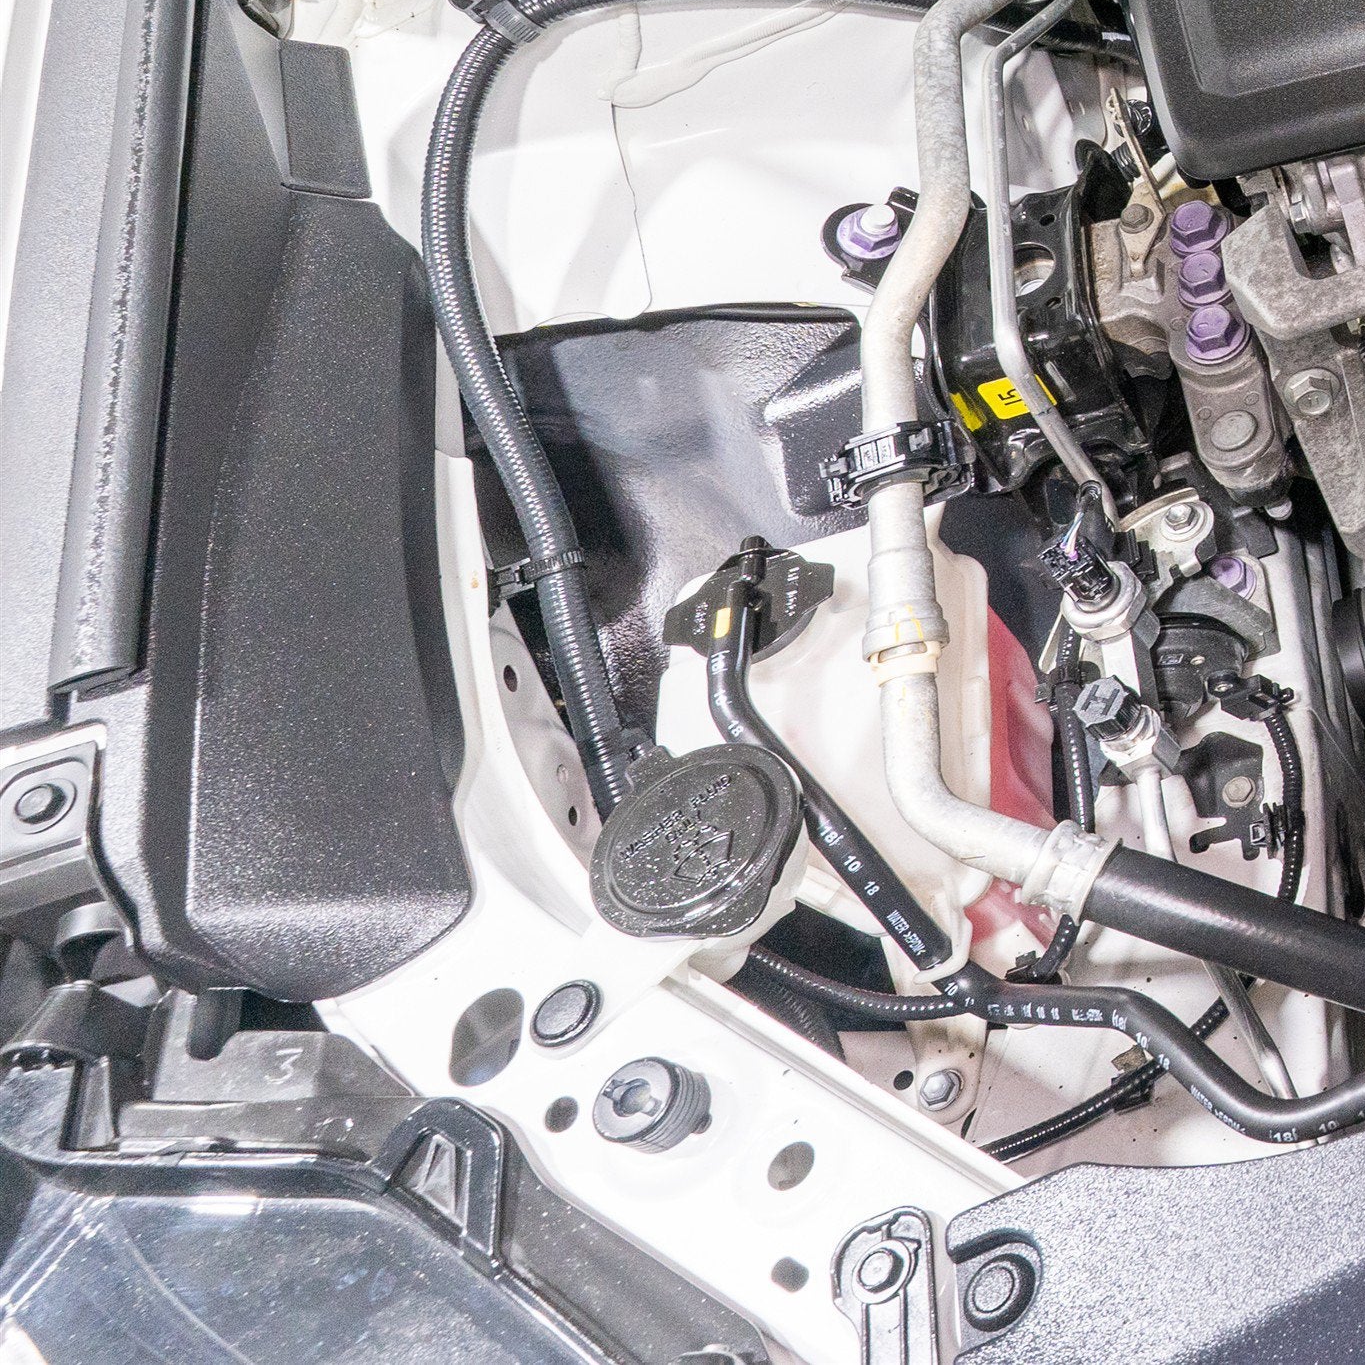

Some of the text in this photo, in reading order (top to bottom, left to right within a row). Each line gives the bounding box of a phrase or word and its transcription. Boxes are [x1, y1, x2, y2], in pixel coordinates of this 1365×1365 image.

[1081, 684, 1121, 716] H
[728, 719, 744, 737] 18
[619, 773, 732, 862] WASHER FLUID
[663, 809, 705, 845] ONLY
[864, 880, 880, 897] 18
[886, 909, 910, 934] WATER
[1189, 1084, 1214, 1112] WATER
